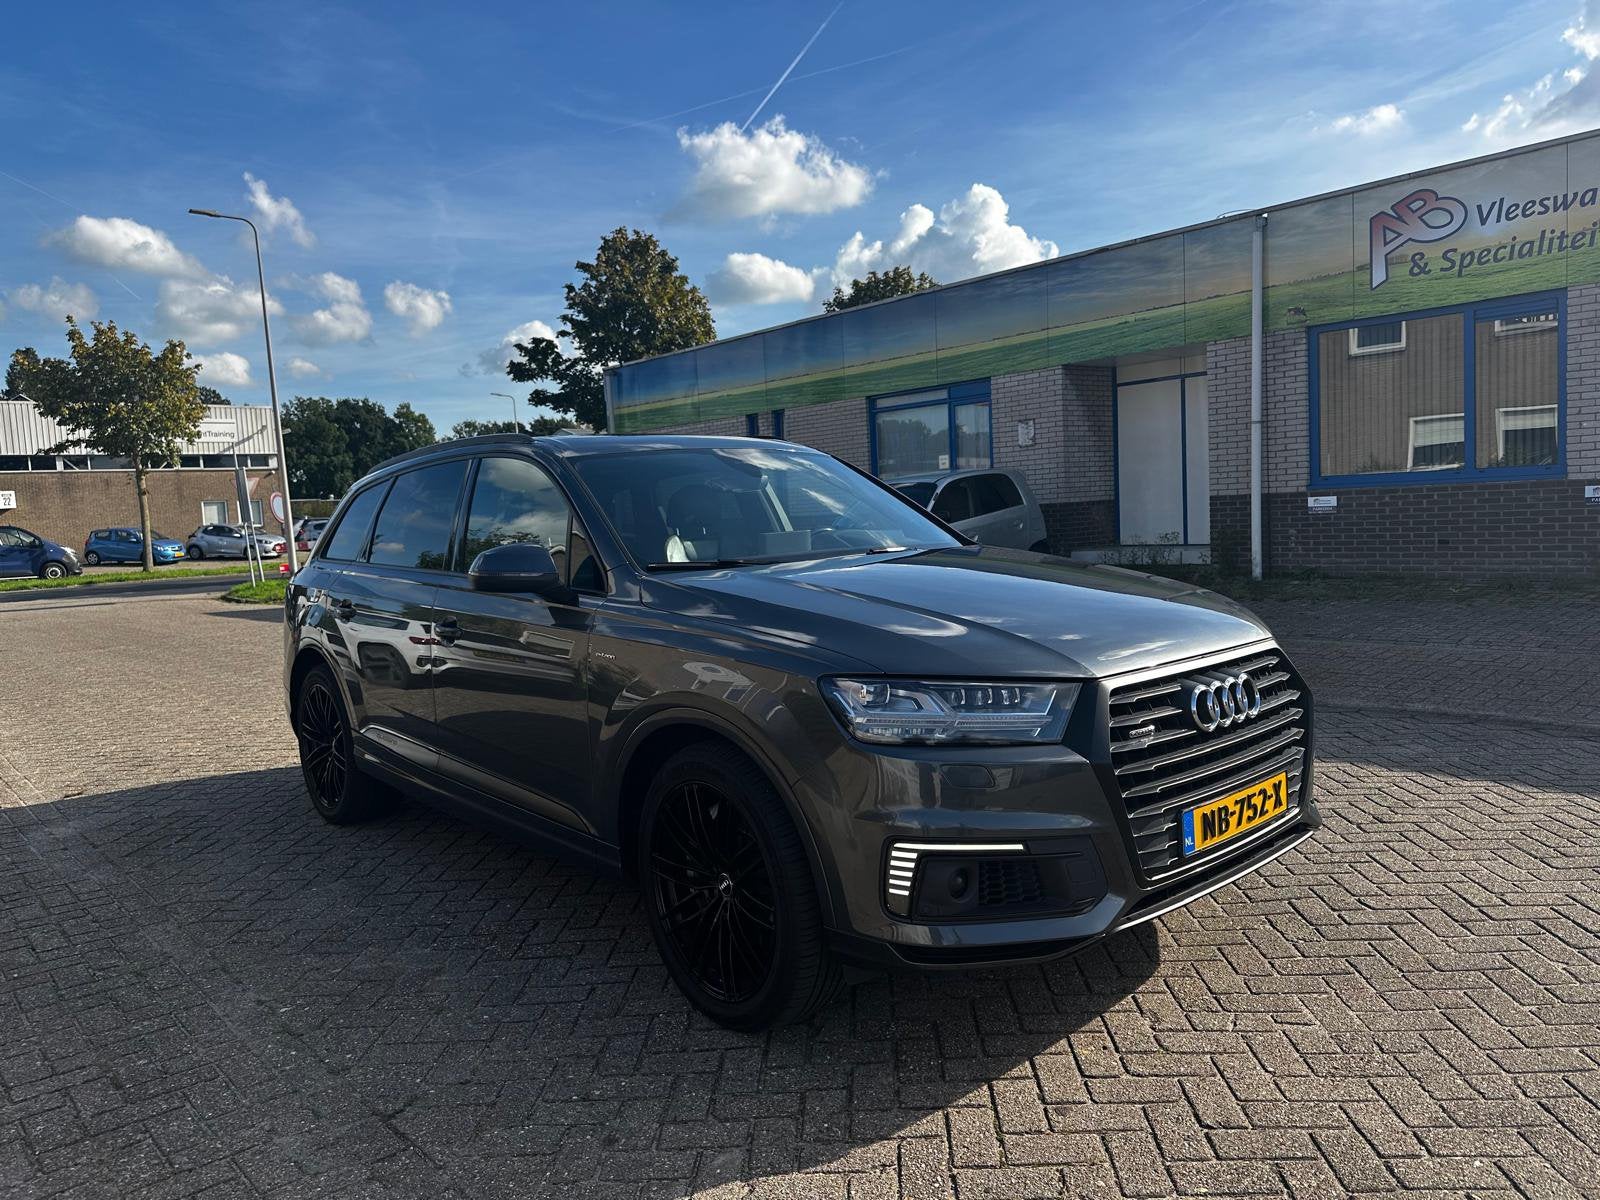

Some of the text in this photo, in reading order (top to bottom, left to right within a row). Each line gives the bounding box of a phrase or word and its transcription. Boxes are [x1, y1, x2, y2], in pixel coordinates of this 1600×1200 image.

[1408, 220, 1600, 278] & Specialitei
[1202, 780, 1283, 842] NB-752-X
[1185, 836, 1194, 847] NL
